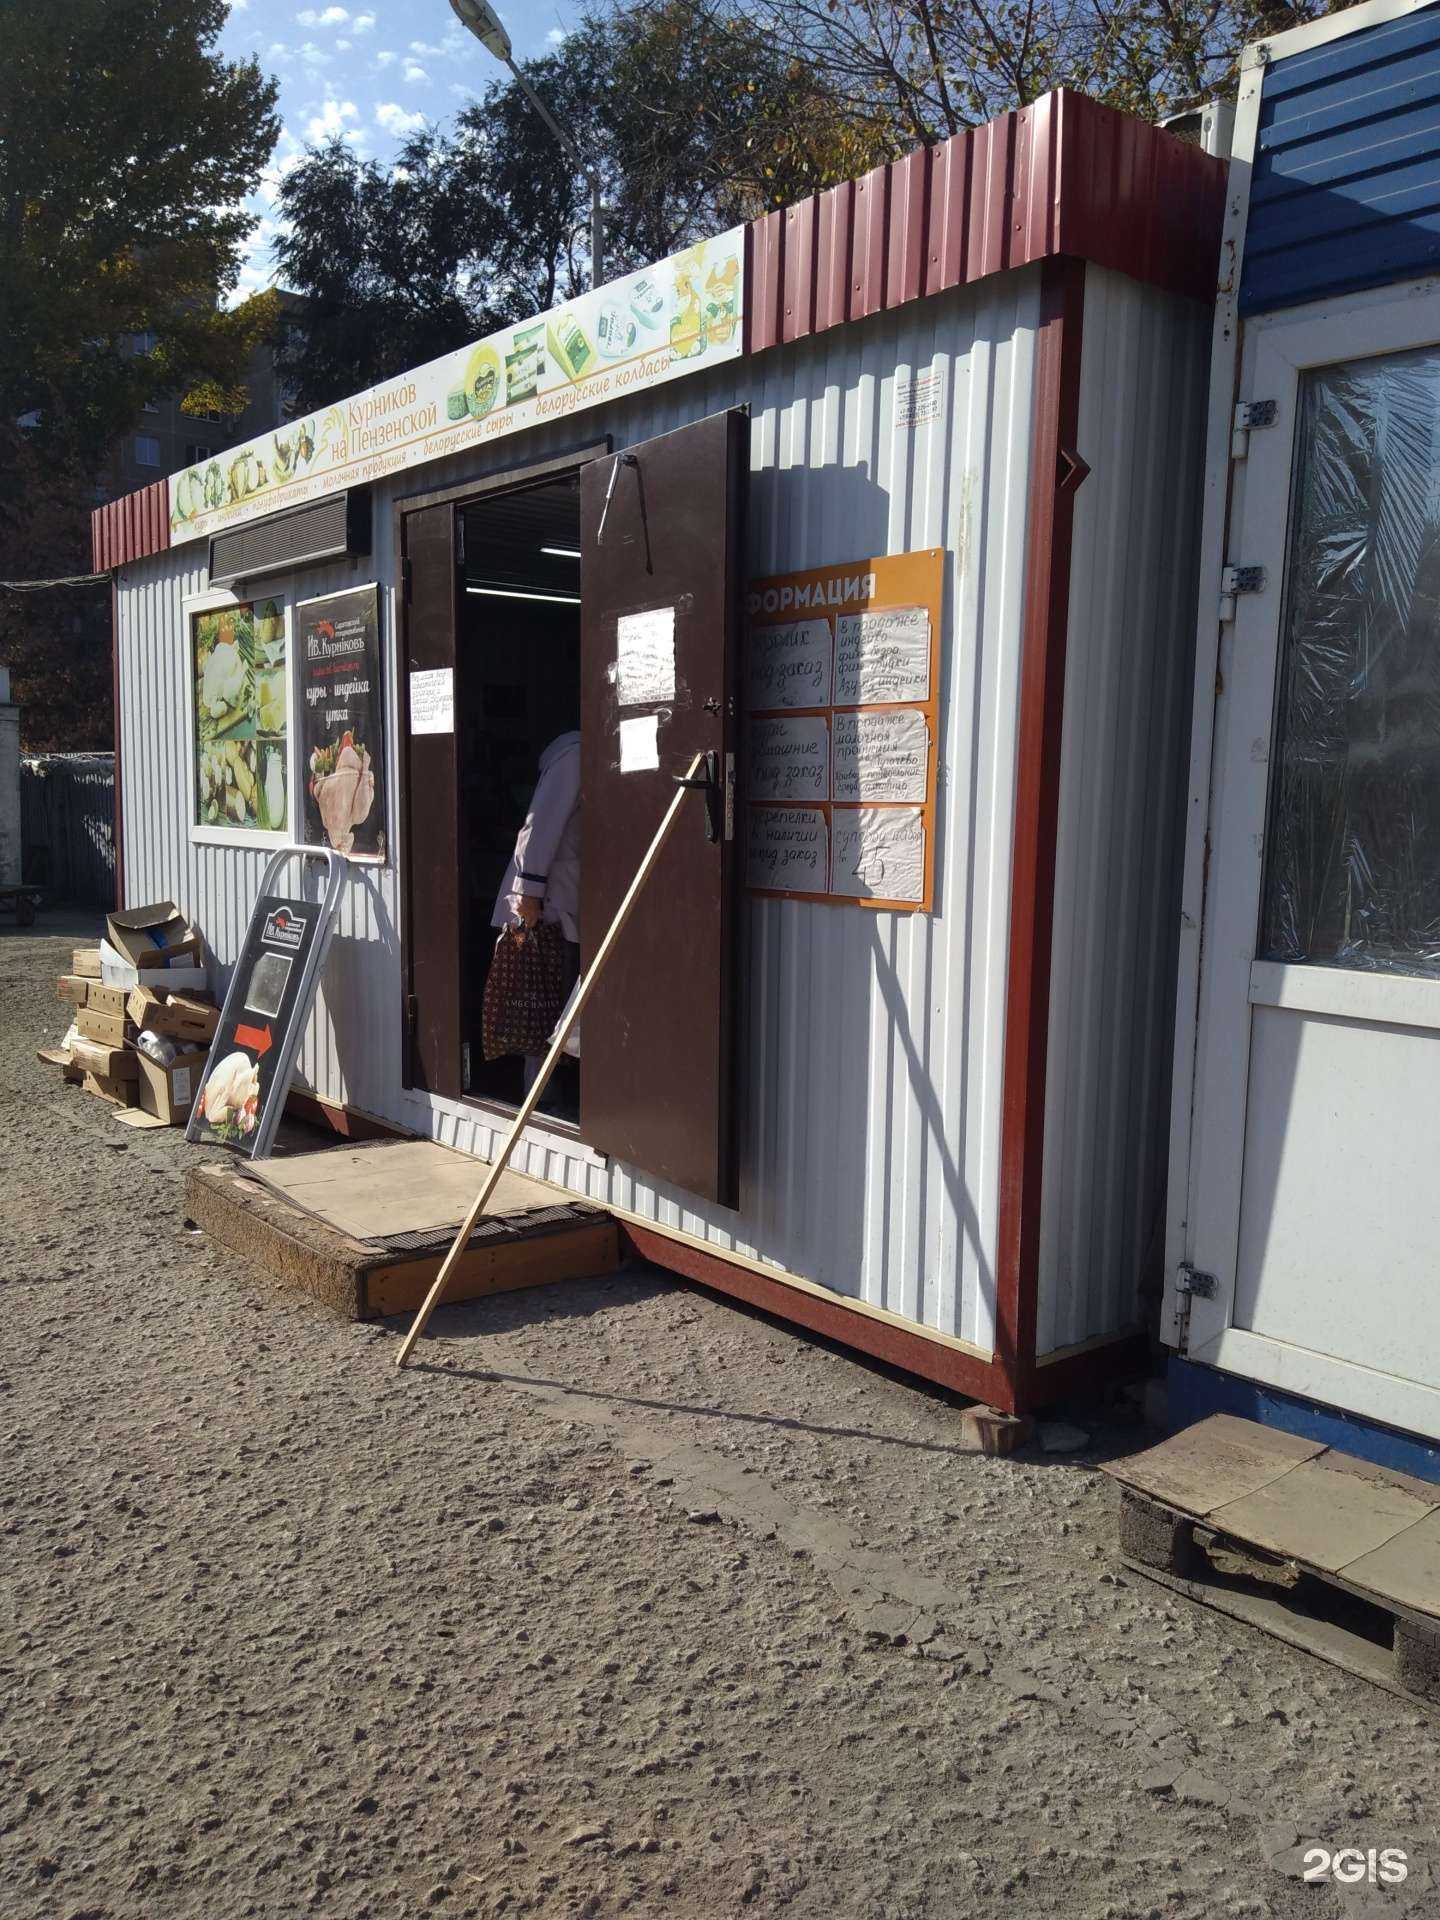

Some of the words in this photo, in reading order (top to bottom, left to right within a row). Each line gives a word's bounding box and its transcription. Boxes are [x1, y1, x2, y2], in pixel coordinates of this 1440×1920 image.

[349, 383, 416, 427] Курников
[362, 451, 407, 477] продукция
[423, 425, 482, 456] белорусские
[486, 413, 513, 436] сыры
[535, 380, 610, 416] белорусские
[615, 355, 672, 387] колбасы
[332, 440, 347, 462] на
[351, 400, 437, 455] Пензенской
[746, 573, 876, 615] ФОРМАЦИЯ
[306, 685, 327, 707] куры
[334, 677, 371, 703] индейка
[325, 708, 348, 730] утка
